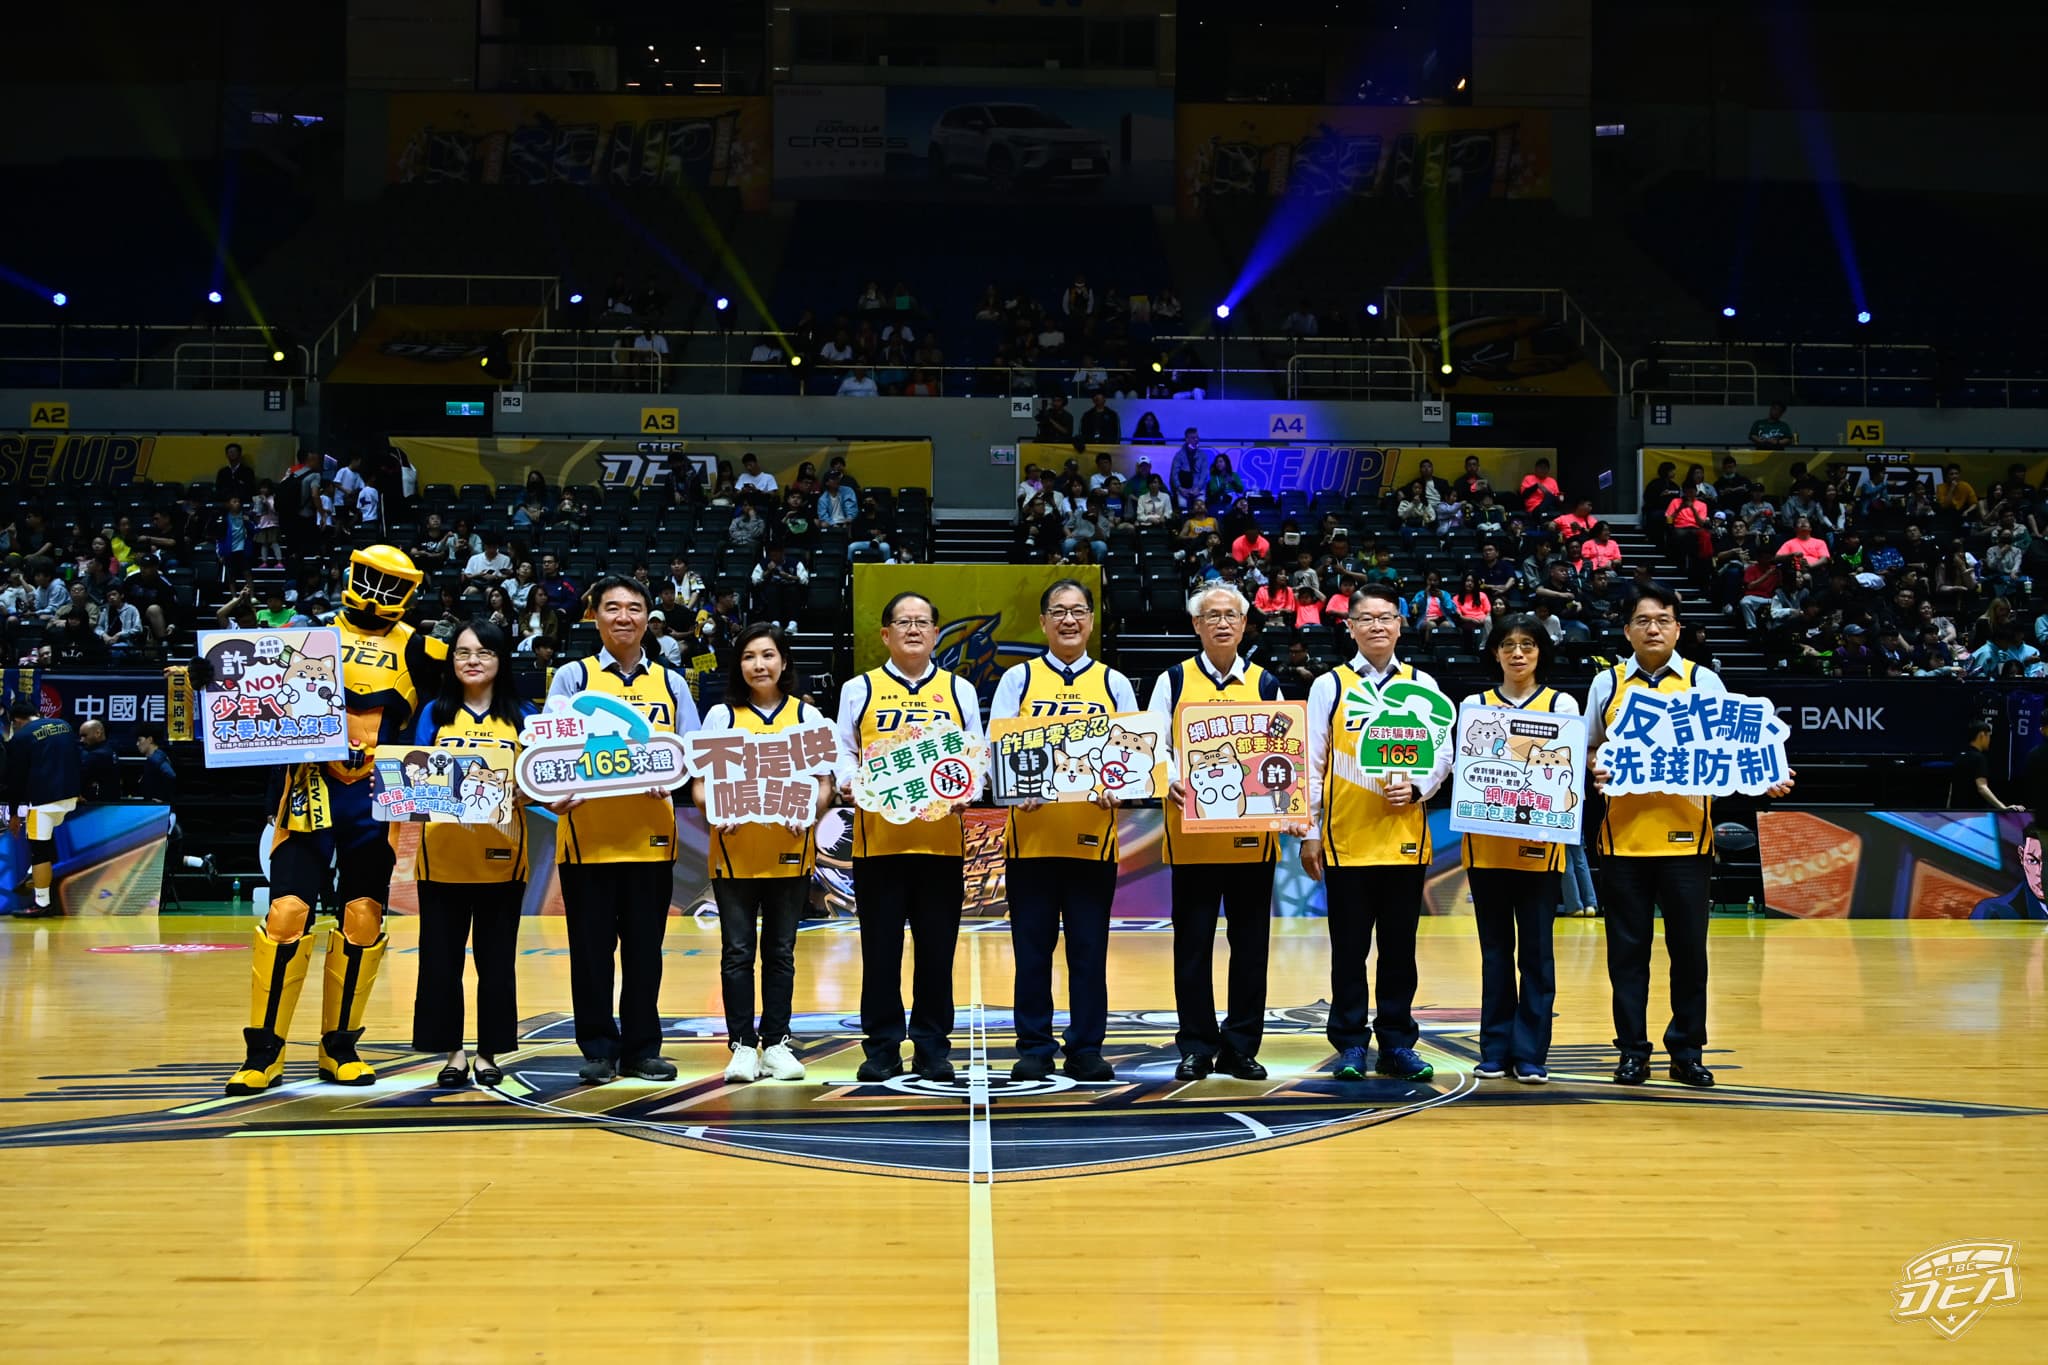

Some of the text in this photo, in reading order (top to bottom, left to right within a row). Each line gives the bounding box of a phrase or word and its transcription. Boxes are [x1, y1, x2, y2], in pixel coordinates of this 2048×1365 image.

[788, 136, 909, 148] CROSS
[34, 407, 66, 423] A2
[643, 414, 675, 430] A3
[1272, 417, 1304, 433] A4
[1850, 425, 1880, 441] A5
[638, 442, 684, 453] CTBC
[1866, 453, 1911, 464] CTBC
[60, 437, 156, 487] UP!
[1308, 447, 1400, 499] UP!
[355, 640, 378, 648] CTBC
[221, 651, 247, 676] 詐
[245, 674, 283, 693] NO!
[616, 693, 644, 701] TBC
[214, 715, 340, 741] 不要以為沒事
[532, 718, 585, 739] 可疑!
[1188, 713, 1271, 743] 網購買賣
[1801, 707, 1885, 730] BANK
[2018, 718, 2030, 736] 6
[1001, 714, 1110, 756] 詐騙零容忍
[1369, 727, 1429, 740] 反詐騙專線
[692, 726, 838, 781] 不提供
[868, 730, 965, 782] 只要青春
[1236, 736, 1301, 755] 都要注意
[1377, 743, 1418, 765] 165
[533, 749, 675, 784] 撥打165求證
[1018, 751, 1040, 772] 詐
[1603, 743, 1781, 787] 洗錢防制
[309, 766, 322, 802] NEW
[1267, 764, 1286, 784] 詐
[713, 779, 812, 820] 帳號
[879, 777, 929, 810] 不要
[1486, 787, 1551, 811] 網購詐騙
[1459, 802, 1574, 828] 幽靈包裹、空包裹
